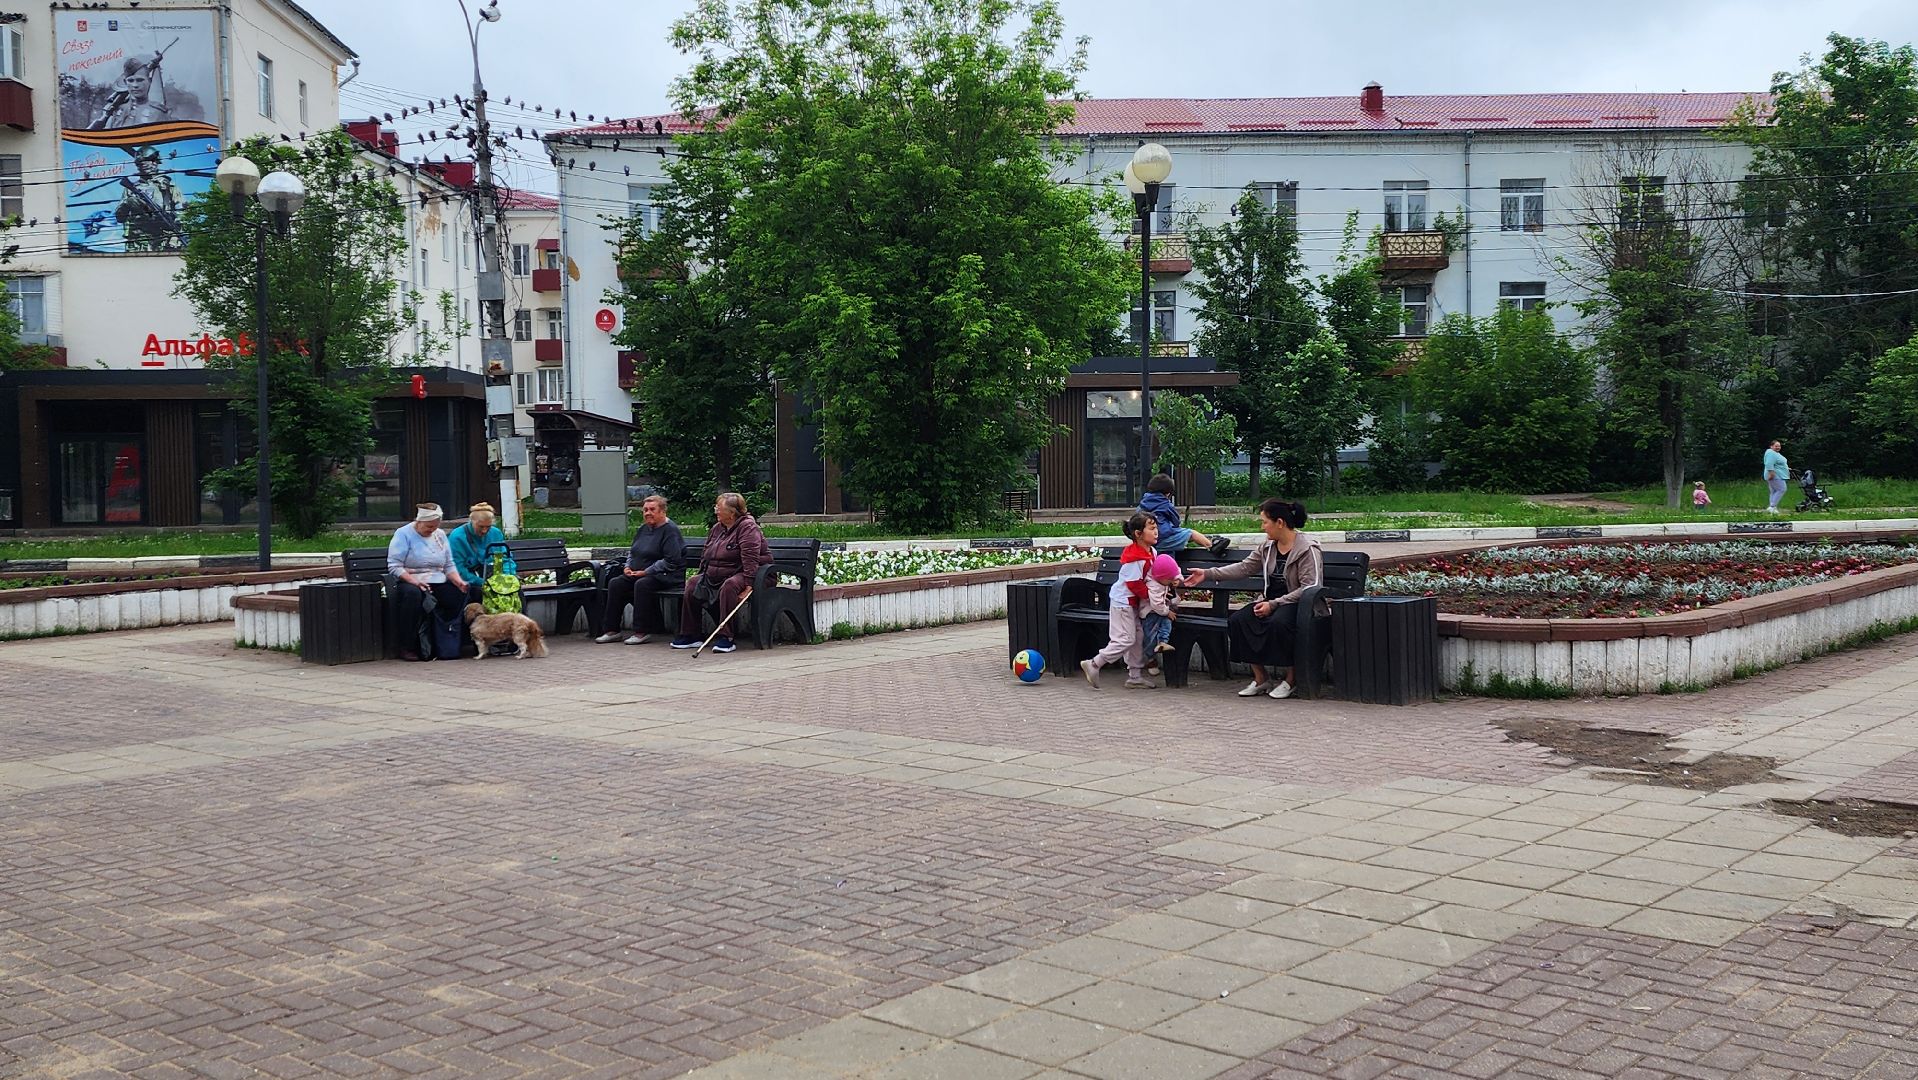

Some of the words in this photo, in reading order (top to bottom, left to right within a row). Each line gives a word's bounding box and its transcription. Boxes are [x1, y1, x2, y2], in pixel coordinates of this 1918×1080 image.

[62, 39, 94, 55] Связь
[68, 48, 124, 72] поколений
[142, 332, 234, 362] Альфа
